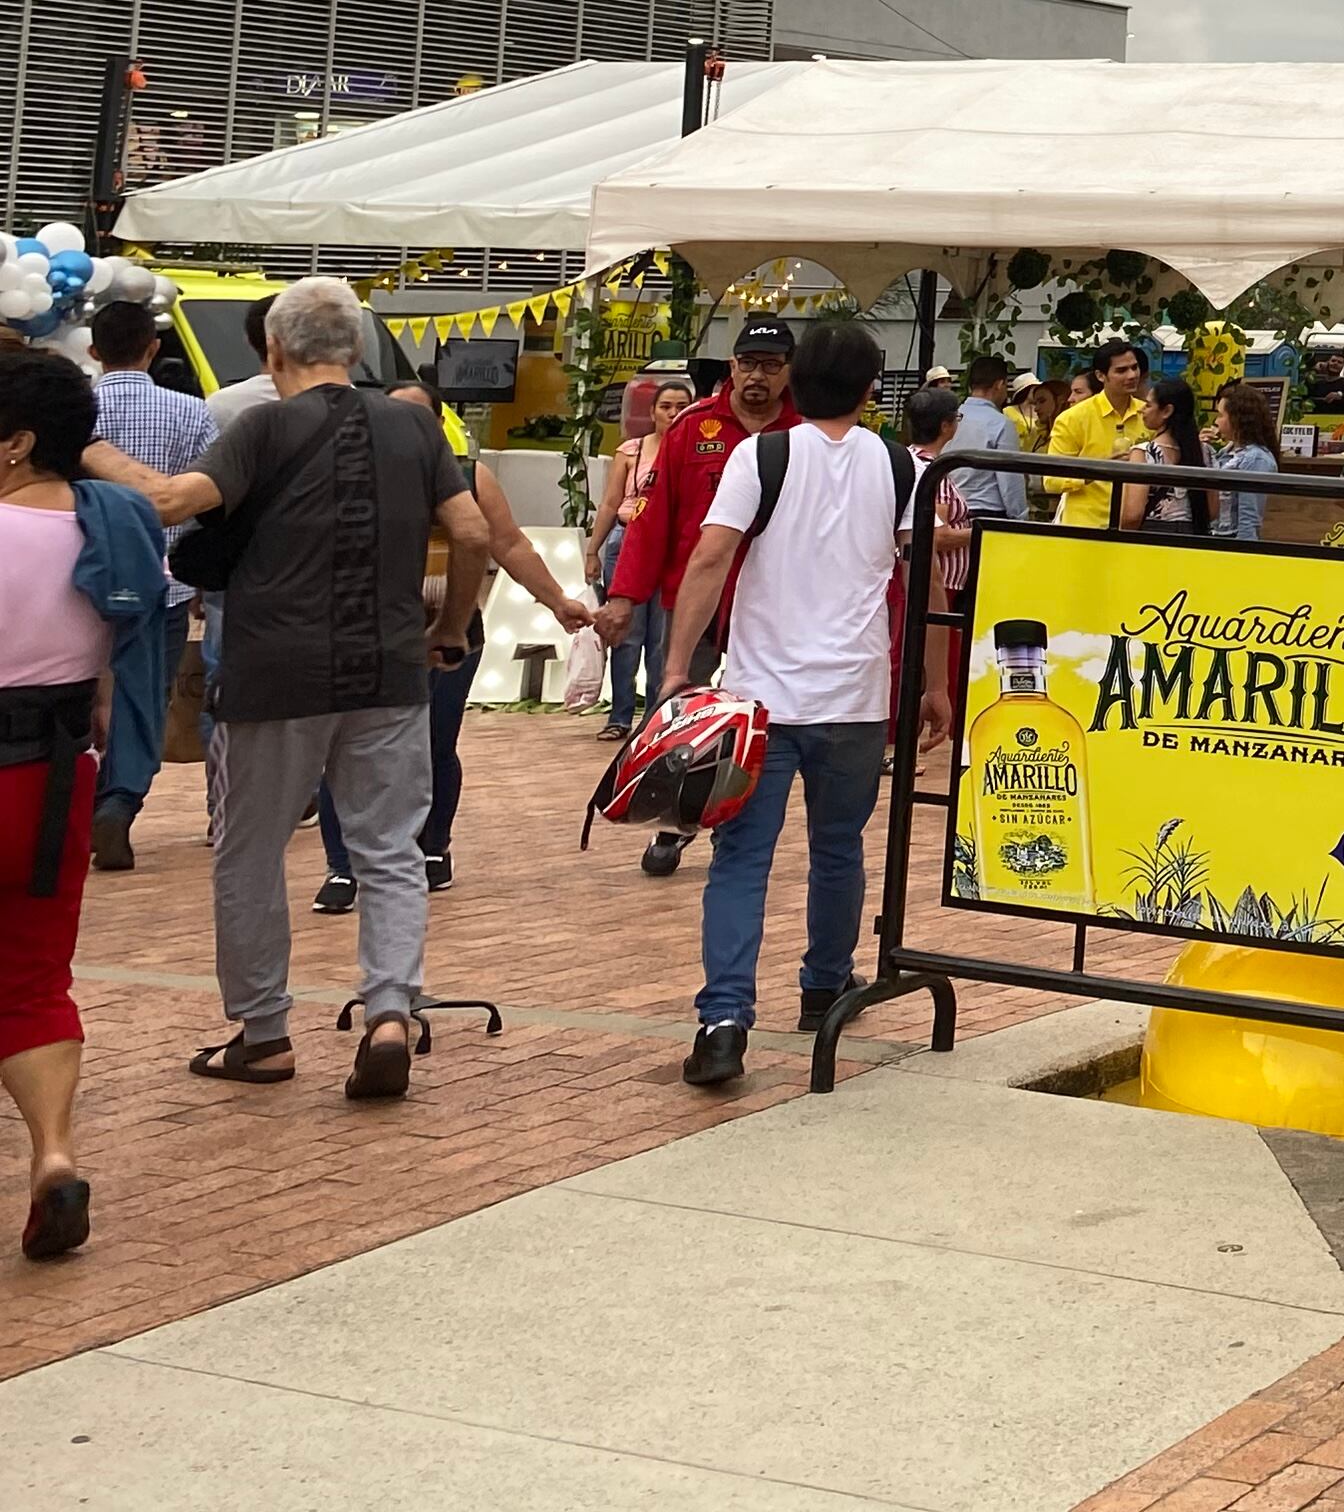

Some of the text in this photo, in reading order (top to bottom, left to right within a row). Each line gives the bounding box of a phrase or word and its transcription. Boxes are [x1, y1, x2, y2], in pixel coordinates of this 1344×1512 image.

[1143, 731, 1179, 750] DE
[986, 741, 1070, 769] Aguardiente
[983, 762, 1077, 796] AMARILLO
[1000, 813, 1065, 825] SIN AZÚCAR
